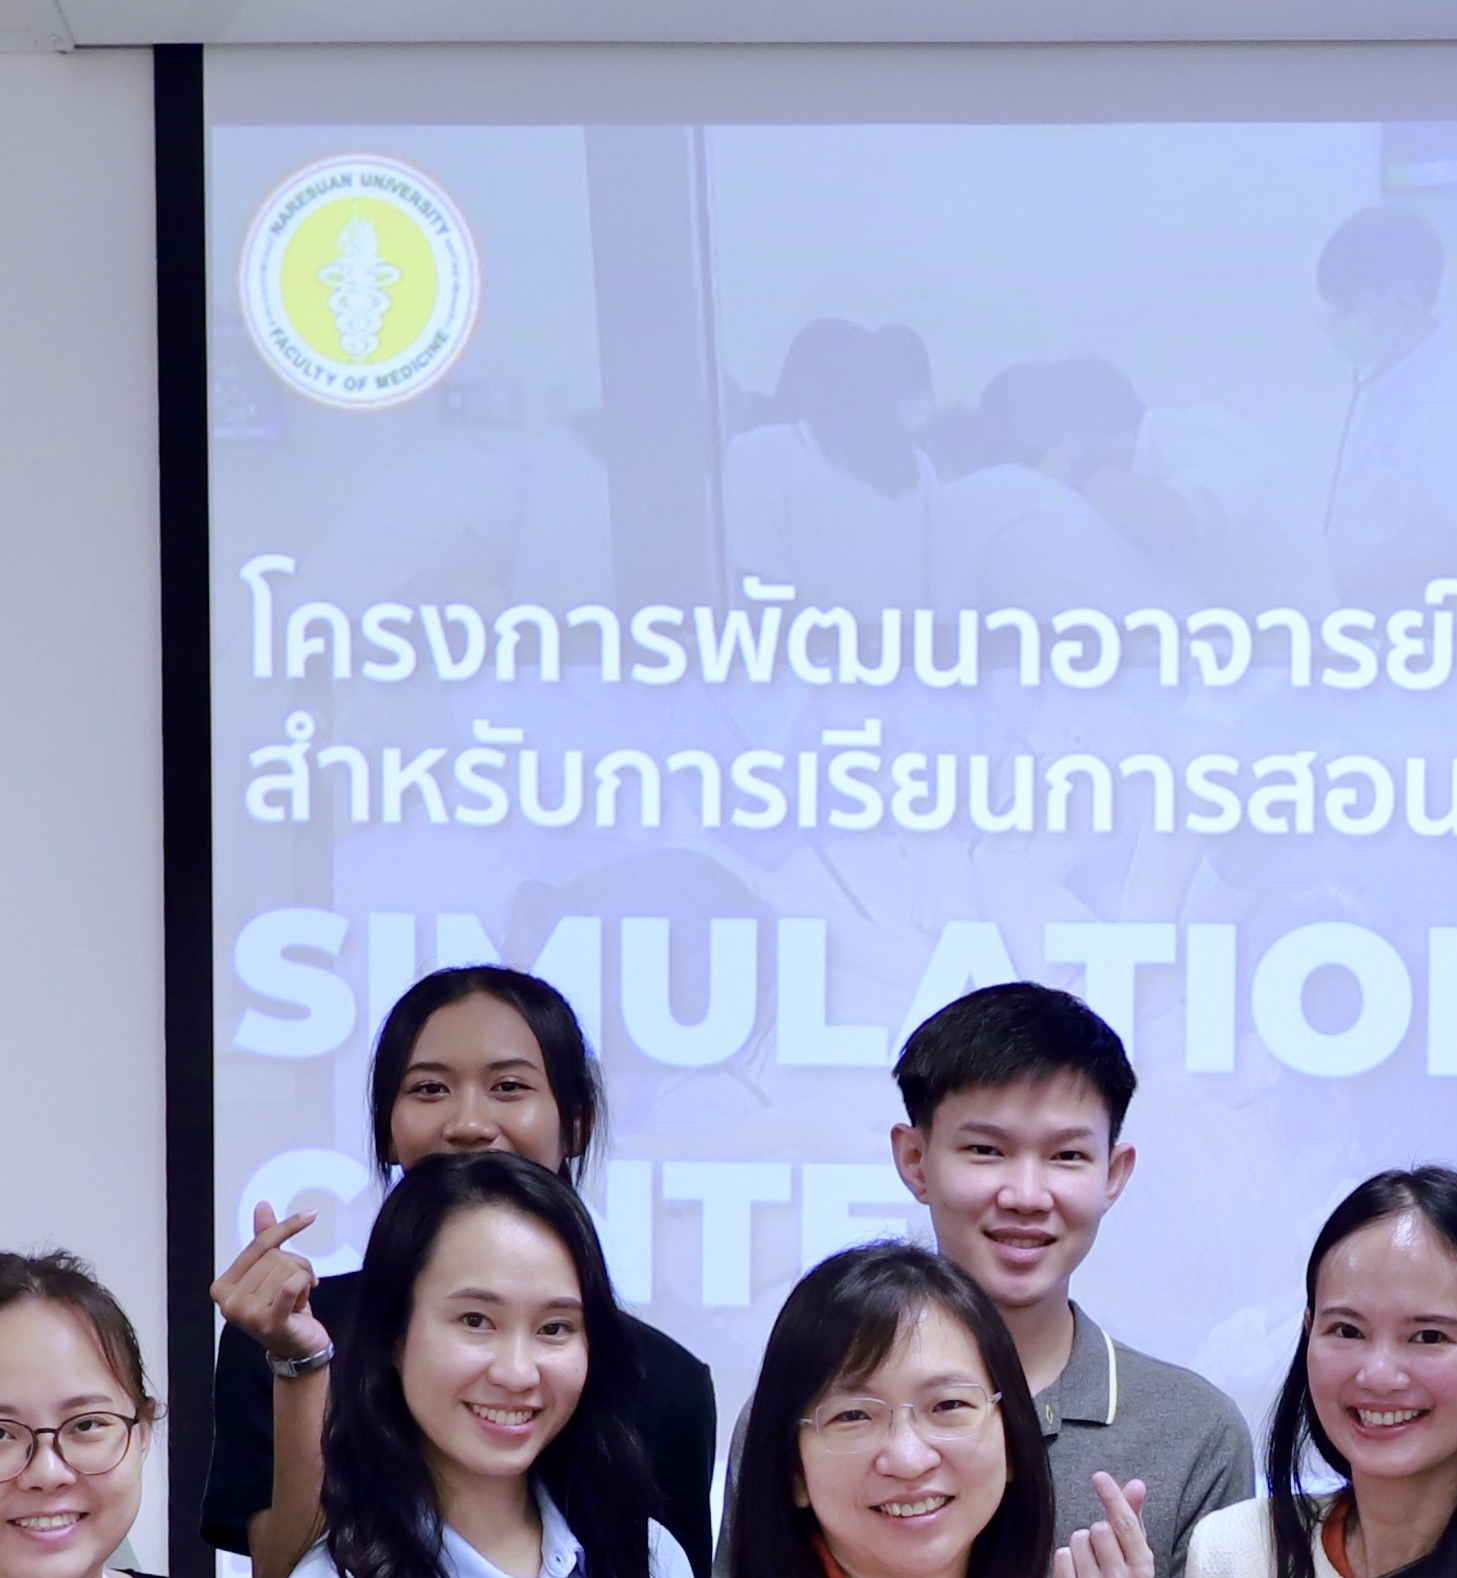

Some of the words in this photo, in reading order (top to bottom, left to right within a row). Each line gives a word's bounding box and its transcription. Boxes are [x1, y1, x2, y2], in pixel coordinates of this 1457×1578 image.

[270, 172, 353, 236] NARESUAN
[359, 172, 452, 237] UNIVERSITY
[270, 326, 338, 387] FACULTY
[344, 374, 369, 392] OF
[375, 328, 451, 391] MEDICINE
